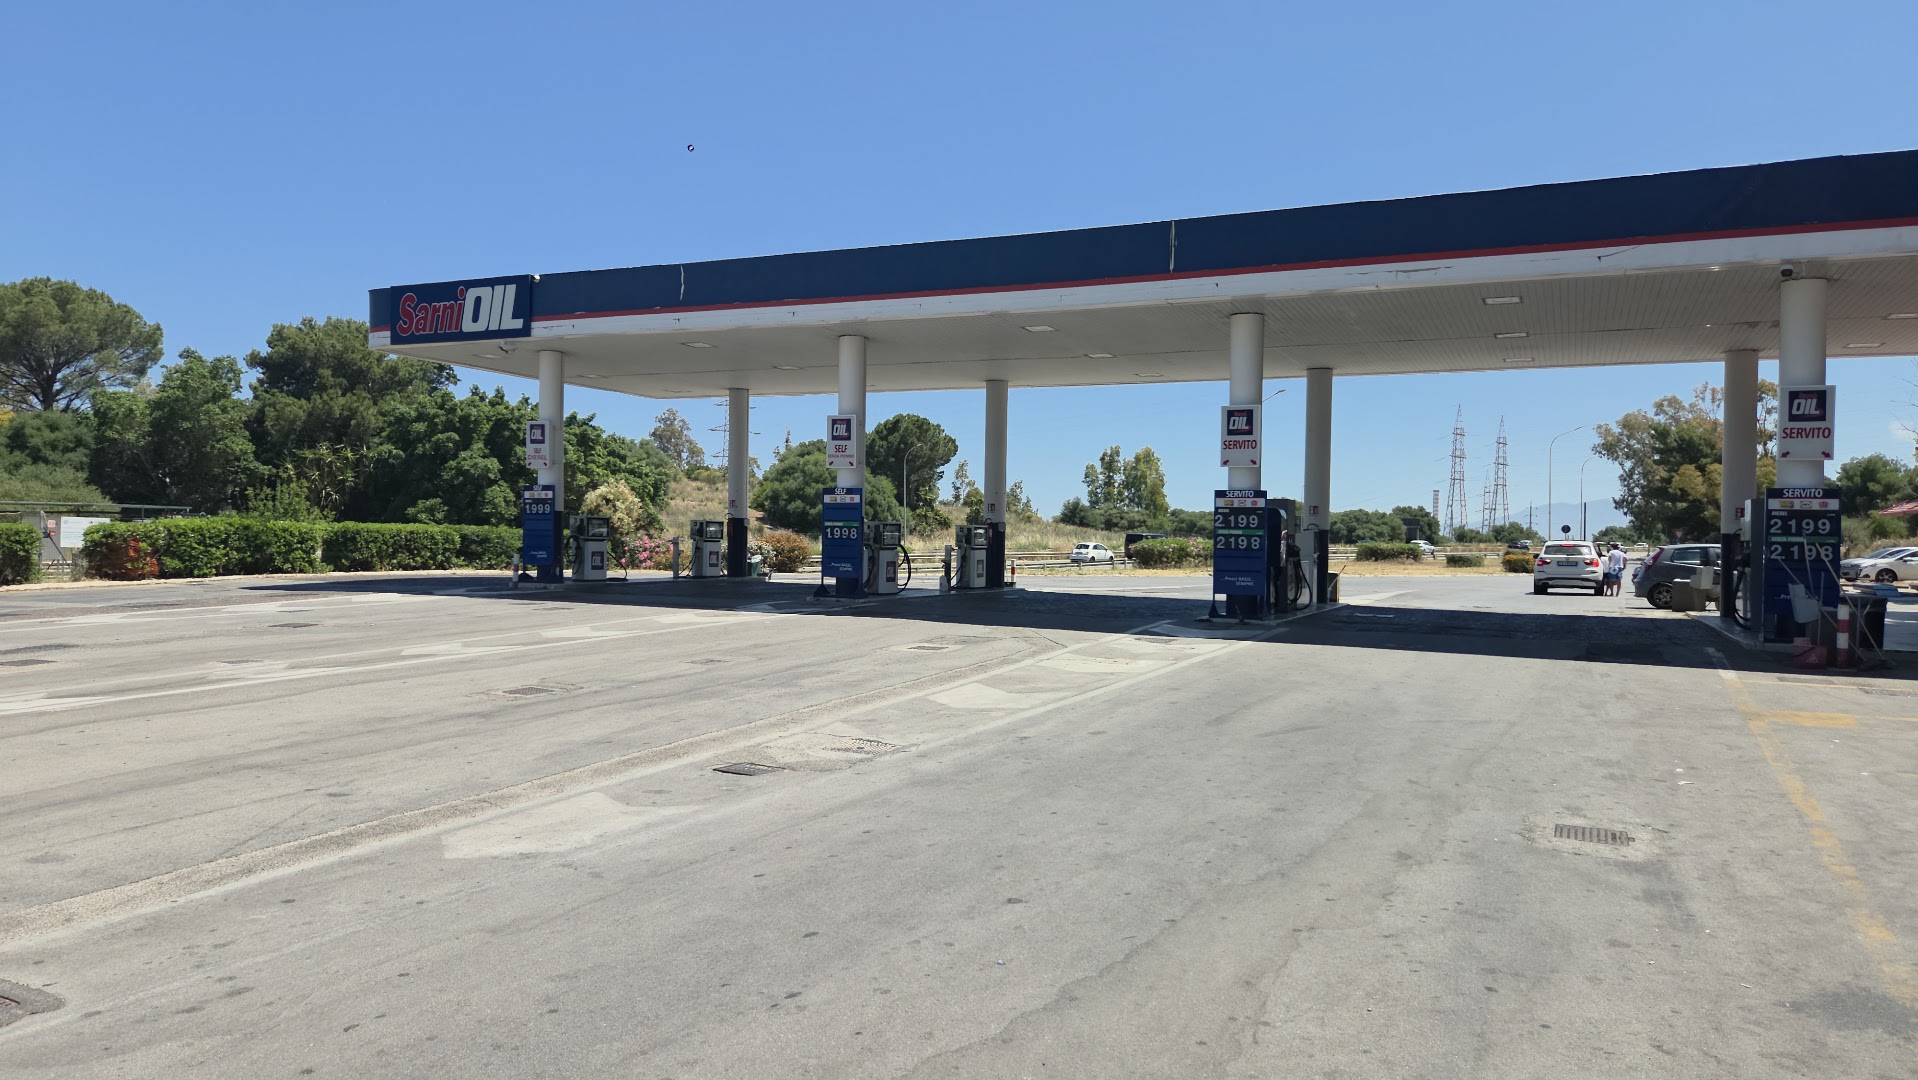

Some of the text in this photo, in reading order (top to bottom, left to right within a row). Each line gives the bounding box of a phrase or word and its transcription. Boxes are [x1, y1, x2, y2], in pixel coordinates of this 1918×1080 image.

[1791, 399, 1820, 415] OIL
[1229, 417, 1249, 430] OIL
[531, 430, 543, 440] OIL
[833, 425, 848, 436] OIL
[1782, 427, 1831, 439] SERVITO
[834, 445, 848, 453] SELF
[1223, 440, 1257, 450] SERVITO
[1225, 490, 1254, 498] SERVITO
[1783, 488, 1823, 498] SERVITO
[1769, 518, 1831, 535] 2199
[1216, 536, 1261, 550] 2198
